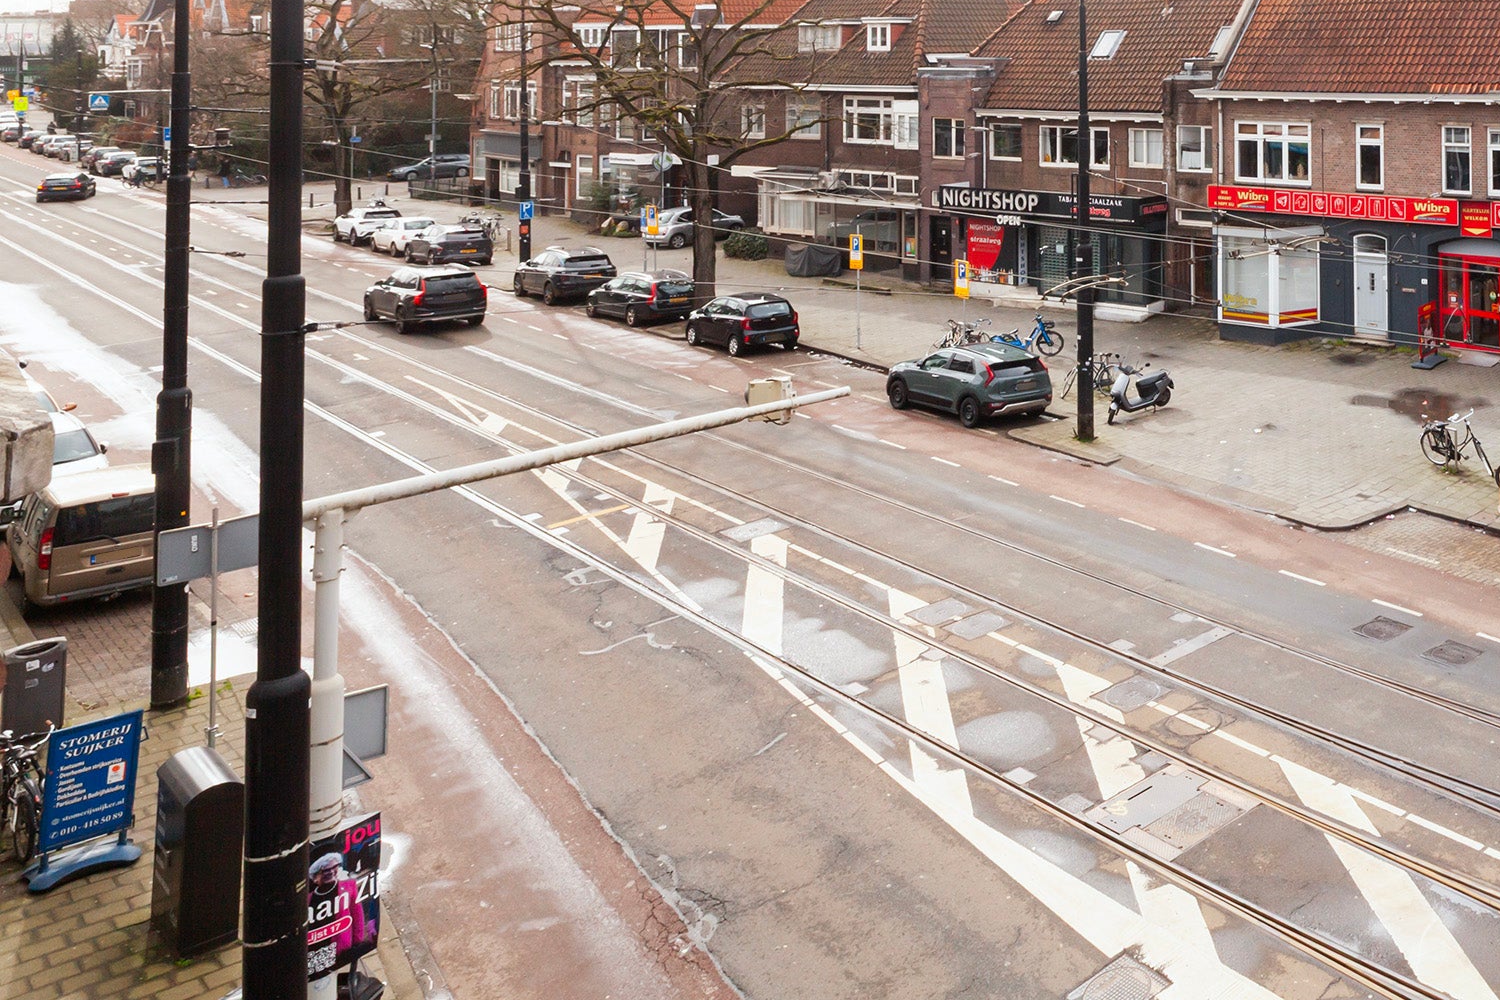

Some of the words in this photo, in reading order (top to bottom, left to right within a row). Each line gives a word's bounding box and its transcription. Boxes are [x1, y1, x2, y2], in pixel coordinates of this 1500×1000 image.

[942, 188, 1038, 212] NIGHTSHOP
[1058, 195, 1123, 207] TABKIAALZAK
[1237, 189, 1269, 202] Wibra
[1413, 200, 1450, 213] Wibra
[969, 223, 1002, 232] NIGHTSHOP
[996, 214, 1021, 226] OPEN
[58, 723, 132, 751] STOMERIJ
[63, 736, 125, 760] SUIJKER
[61, 797, 126, 822] stomerijsuijker.nl
[60, 825, 77, 836] 010
[83, 818, 99, 829] 418
[100, 814, 112, 824] 50
[112, 810, 124, 821] 89
[343, 818, 381, 854] jou
[329, 923, 342, 935] 17
